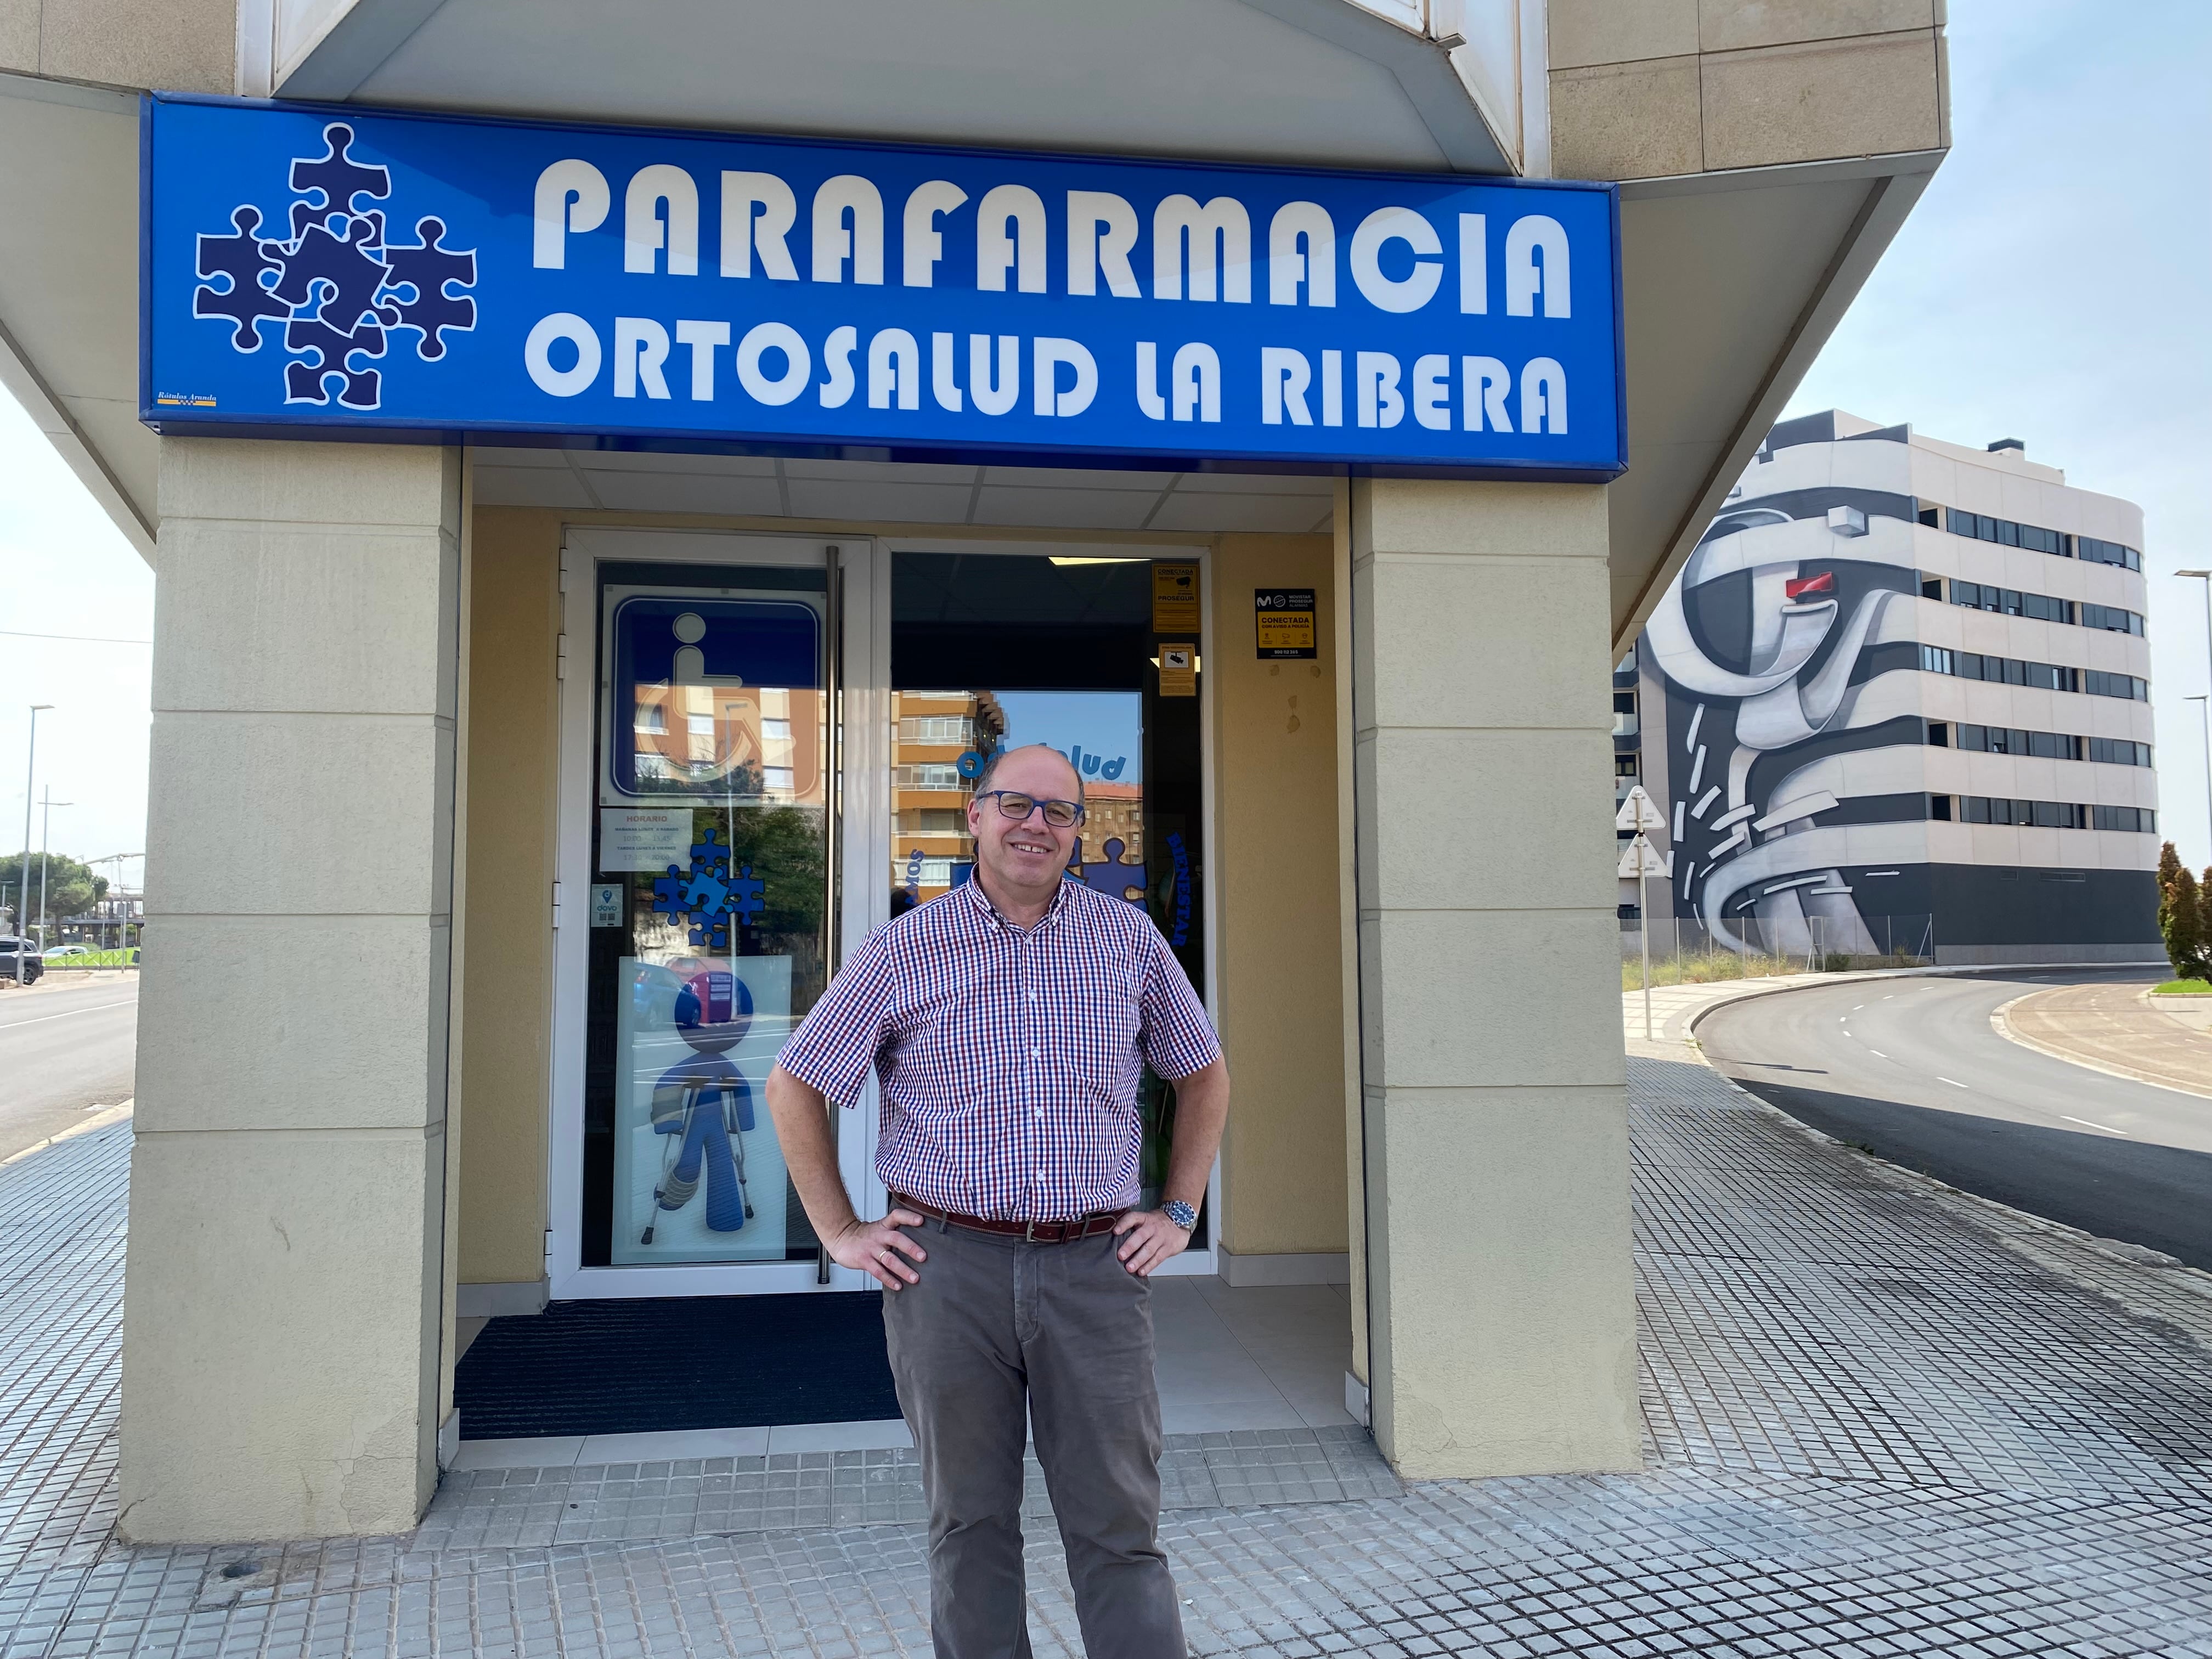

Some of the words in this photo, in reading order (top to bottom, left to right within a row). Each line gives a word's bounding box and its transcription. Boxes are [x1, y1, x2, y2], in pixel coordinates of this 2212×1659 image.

[533, 160, 1571, 319] PARAFARMACIA
[524, 313, 1098, 419] ORTOSALUD
[1136, 342, 1221, 423] LA
[1261, 347, 1568, 435] RIBERA
[1165, 831, 1192, 947] BIENESTAR
